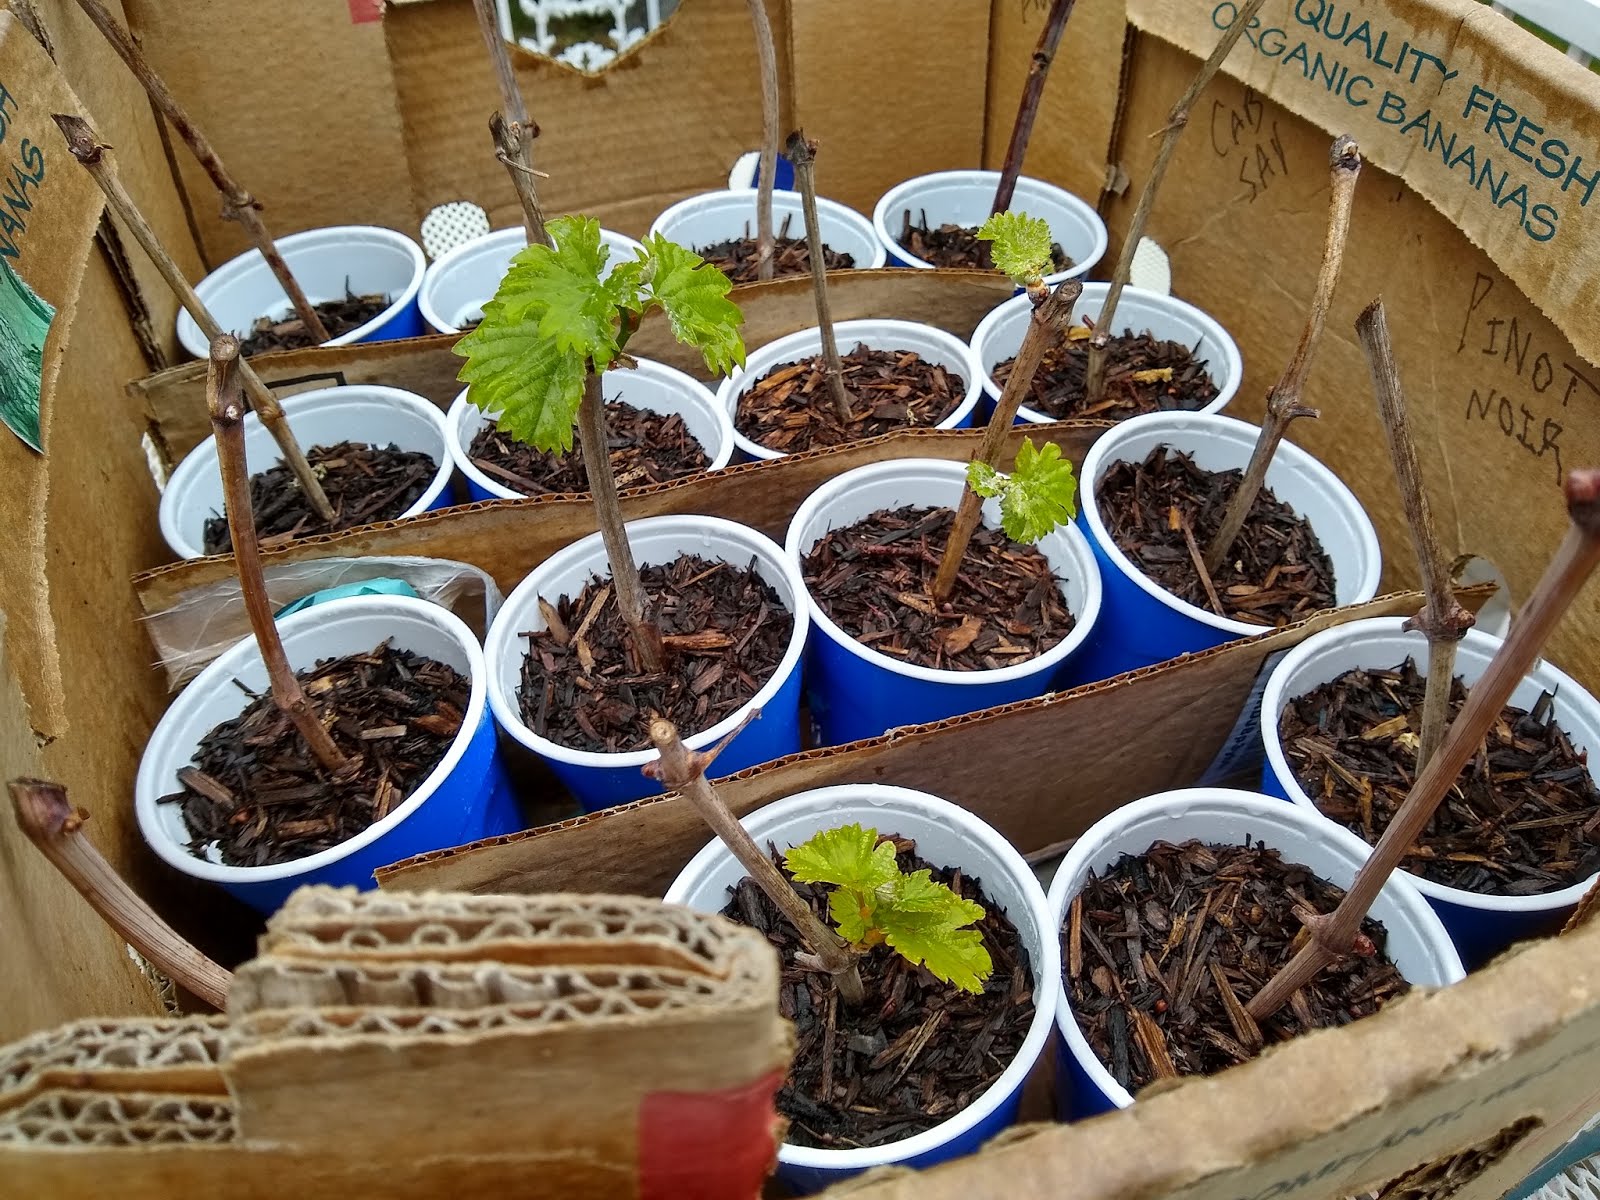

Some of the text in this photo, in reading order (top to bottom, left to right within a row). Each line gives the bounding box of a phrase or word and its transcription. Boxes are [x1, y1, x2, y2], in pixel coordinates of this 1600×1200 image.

[1211, 87, 1264, 157] CAB
[1212, 1, 1559, 242] ORGANIC BANANAS
[1295, 0, 1600, 207] QUALITY FRESH
[1457, 271, 1600, 407] PINOT
[1466, 388, 1563, 487] NOIR
